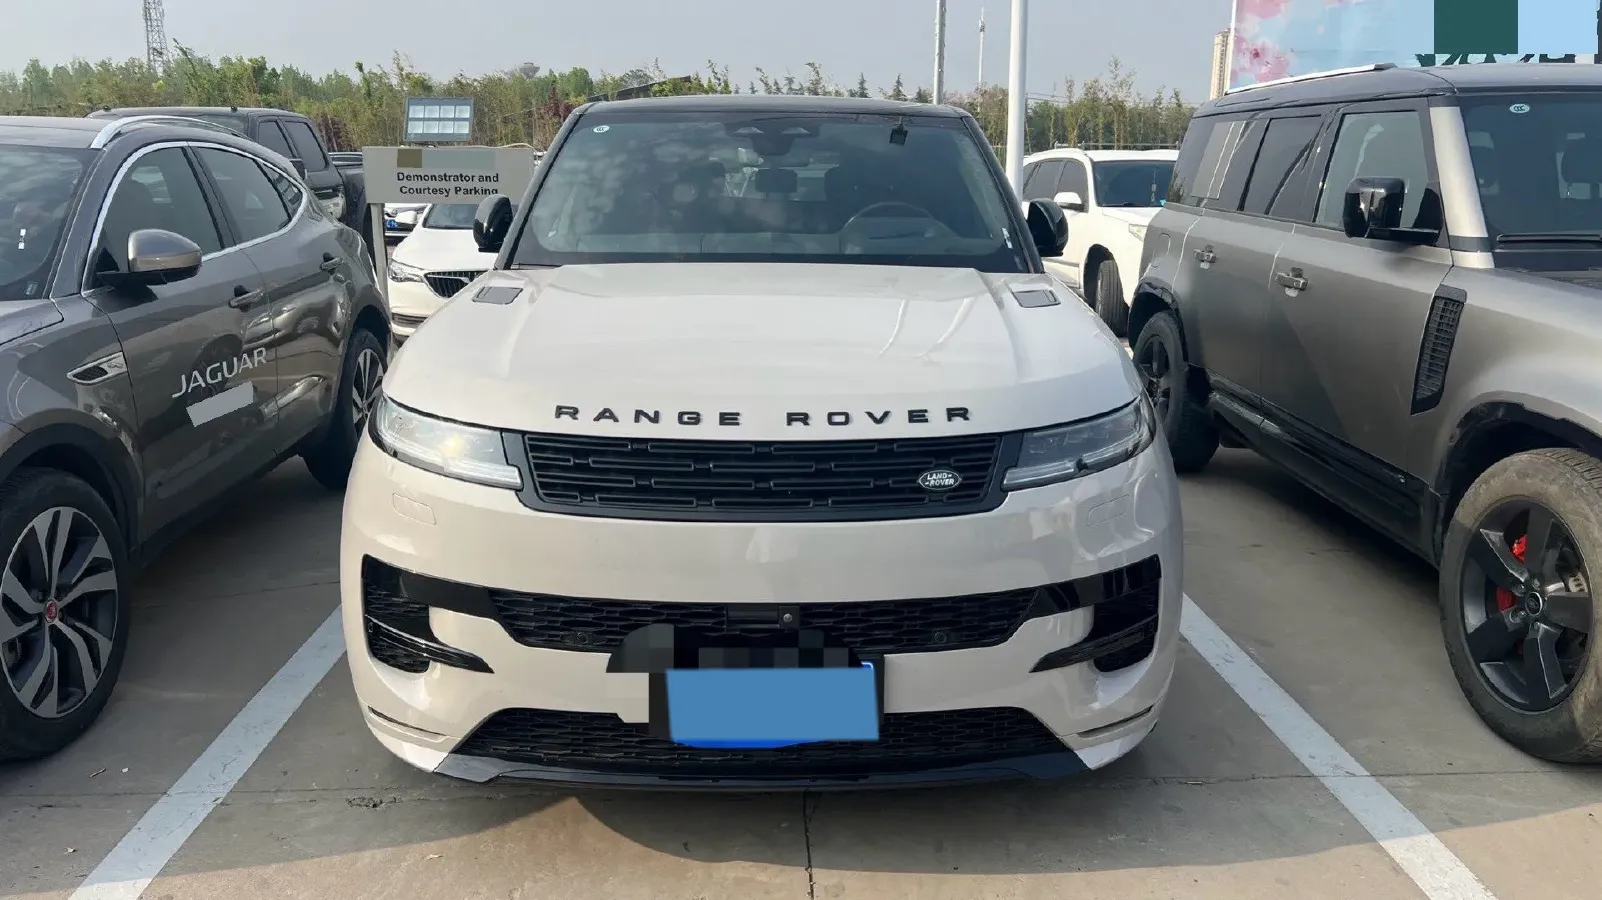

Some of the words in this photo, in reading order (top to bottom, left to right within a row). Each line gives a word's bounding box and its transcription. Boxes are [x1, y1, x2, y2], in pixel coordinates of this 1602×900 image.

[397, 172, 476, 182] Demonstrator
[478, 173, 499, 182] and
[399, 185, 451, 197] Courtesy
[172, 347, 267, 398] JAGUAR
[555, 405, 741, 426] RANGE
[786, 407, 971, 426] ROVER
